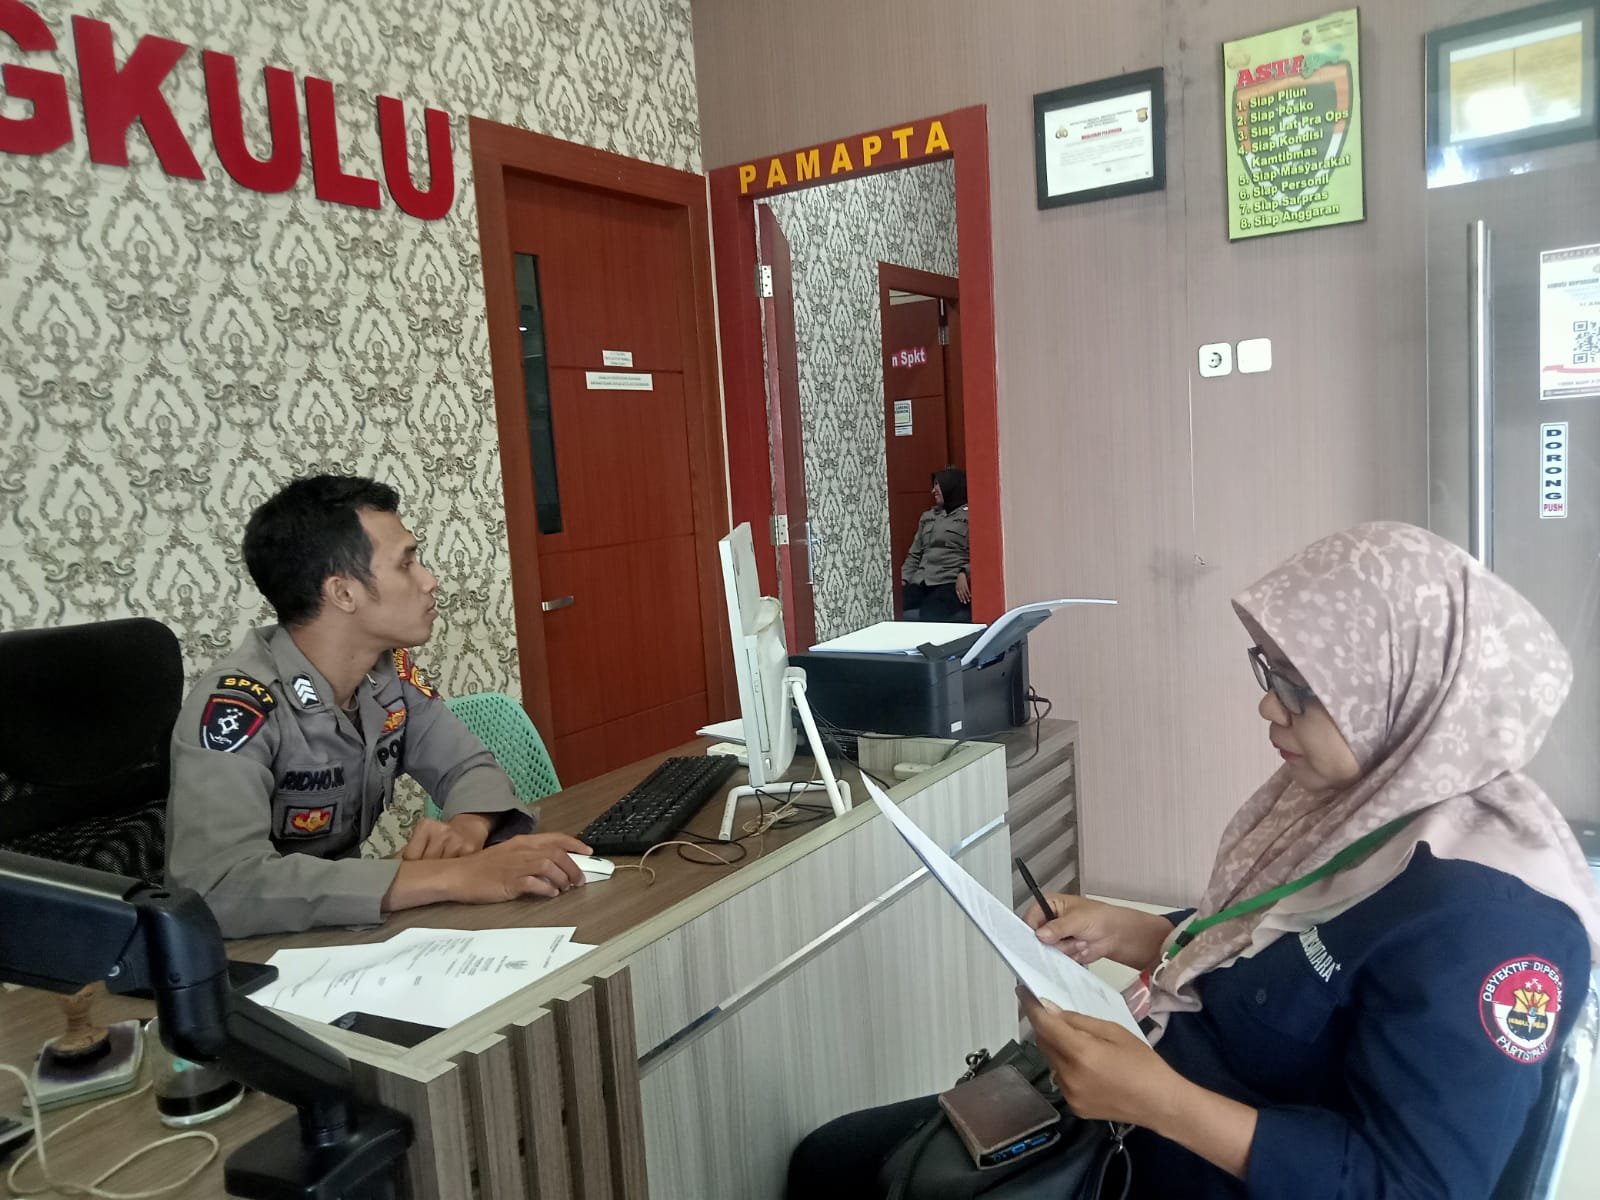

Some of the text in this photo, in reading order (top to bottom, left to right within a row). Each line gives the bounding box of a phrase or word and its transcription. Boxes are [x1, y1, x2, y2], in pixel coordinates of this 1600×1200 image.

[0, 0, 454, 220] GKULU
[1237, 87, 1307, 112] 1. Siap Pilun
[1237, 100, 1314, 127] 2. Siap Posko
[1238, 110, 1349, 141] 3. Siap Lat Pra Ops
[1238, 129, 1324, 155] 4. Siap Kondisi
[739, 120, 950, 194] PAMAPTA
[1239, 154, 1351, 185] 5. Siap Masyarakat
[1252, 147, 1318, 168] Kamtibmas
[1239, 173, 1329, 200] 6. Siap Personil
[1240, 191, 1329, 215] 7. Siap Sarpras
[1240, 204, 1340, 229] 8. Siap Anggaran
[900, 346, 926, 368] Spkt
[1545, 429, 1562, 500] DORONG
[1543, 503, 1564, 513] PUSH
[223, 677, 274, 705] SPKT
[1482, 961, 1529, 1002] OBYEKTIF
